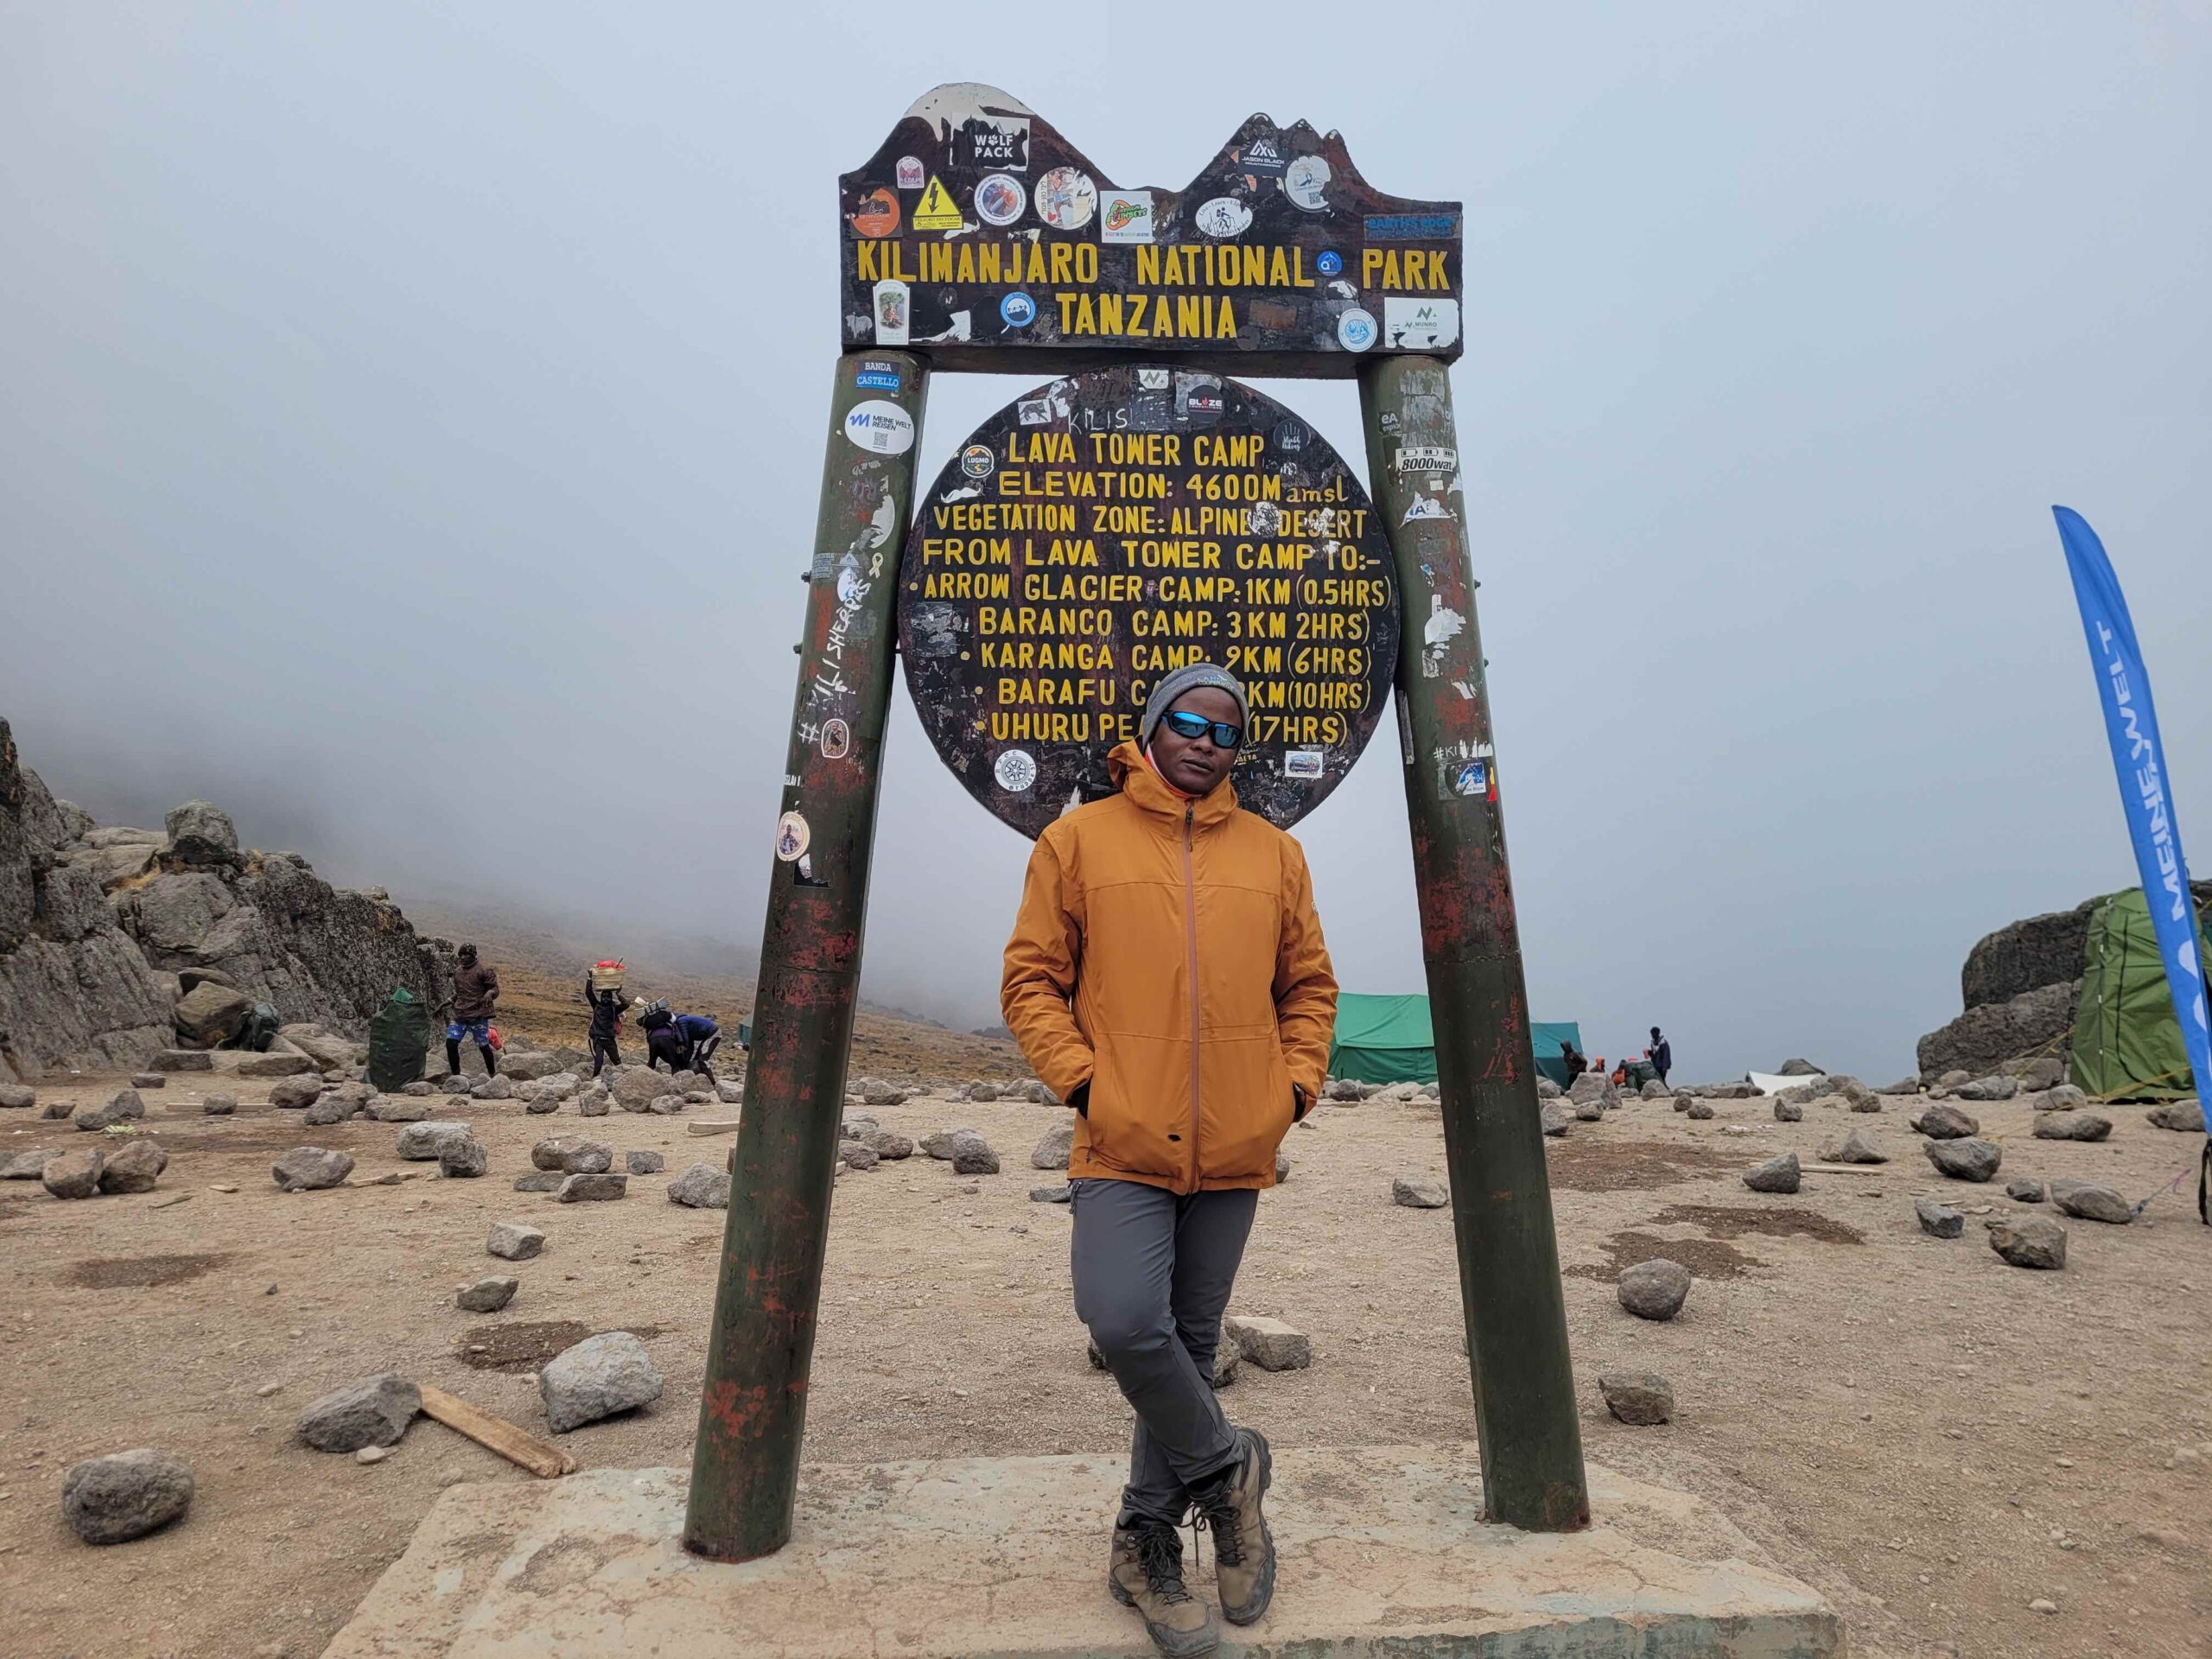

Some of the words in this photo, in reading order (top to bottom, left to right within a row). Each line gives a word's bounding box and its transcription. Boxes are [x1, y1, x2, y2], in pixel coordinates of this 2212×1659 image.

[975, 146, 1014, 158] PACK
[858, 240, 1098, 284] KILIMANJARO
[1136, 245, 1315, 288] NATIONAL
[1363, 249, 1449, 290] PARK
[1055, 292, 1237, 340] TANZANIA
[856, 376, 899, 388] CASTELLO
[865, 362, 892, 372] BANDA
[872, 415, 893, 425] MEINE
[895, 419, 912, 430] WELT
[872, 421, 897, 432] REISEN
[1009, 432, 1077, 464] LAVA
[1090, 433, 1180, 466] TOWER
[1194, 435, 1264, 467] CAMP
[1000, 471, 1173, 499] ELEVATION:
[1185, 474, 1281, 501] 4600M
[1286, 475, 1349, 504] amsl
[933, 504, 1076, 532] VEGETATION
[1278, 509, 1367, 539] DESERT
[923, 537, 1012, 566] FROM
[1026, 538, 1099, 567] LAVA
[1121, 540, 1221, 569] TOWER
[1236, 543, 1314, 571] CAMP
[924, 572, 1010, 599] ARROW
[1025, 573, 1143, 602] GLACIER
[1159, 575, 1242, 603] CAMP:
[1296, 574, 1392, 612] (0.5HRS)
[979, 607, 1113, 637] BARANCO
[1132, 610, 1218, 638] CAMP:
[1296, 608, 1370, 645] 2HRS)
[982, 642, 1114, 671] KARANGA
[1225, 645, 1282, 674] 9KM
[1287, 641, 1373, 681] (6HRS)
[998, 677, 1116, 706] BARAFU
[1287, 680, 1371, 714] (10HRS)
[2095, 620, 2158, 773] WELT
[991, 712, 1090, 742] UHURU
[1246, 710, 1349, 748] (17HRS)
[2136, 768, 2185, 923] MEINE
